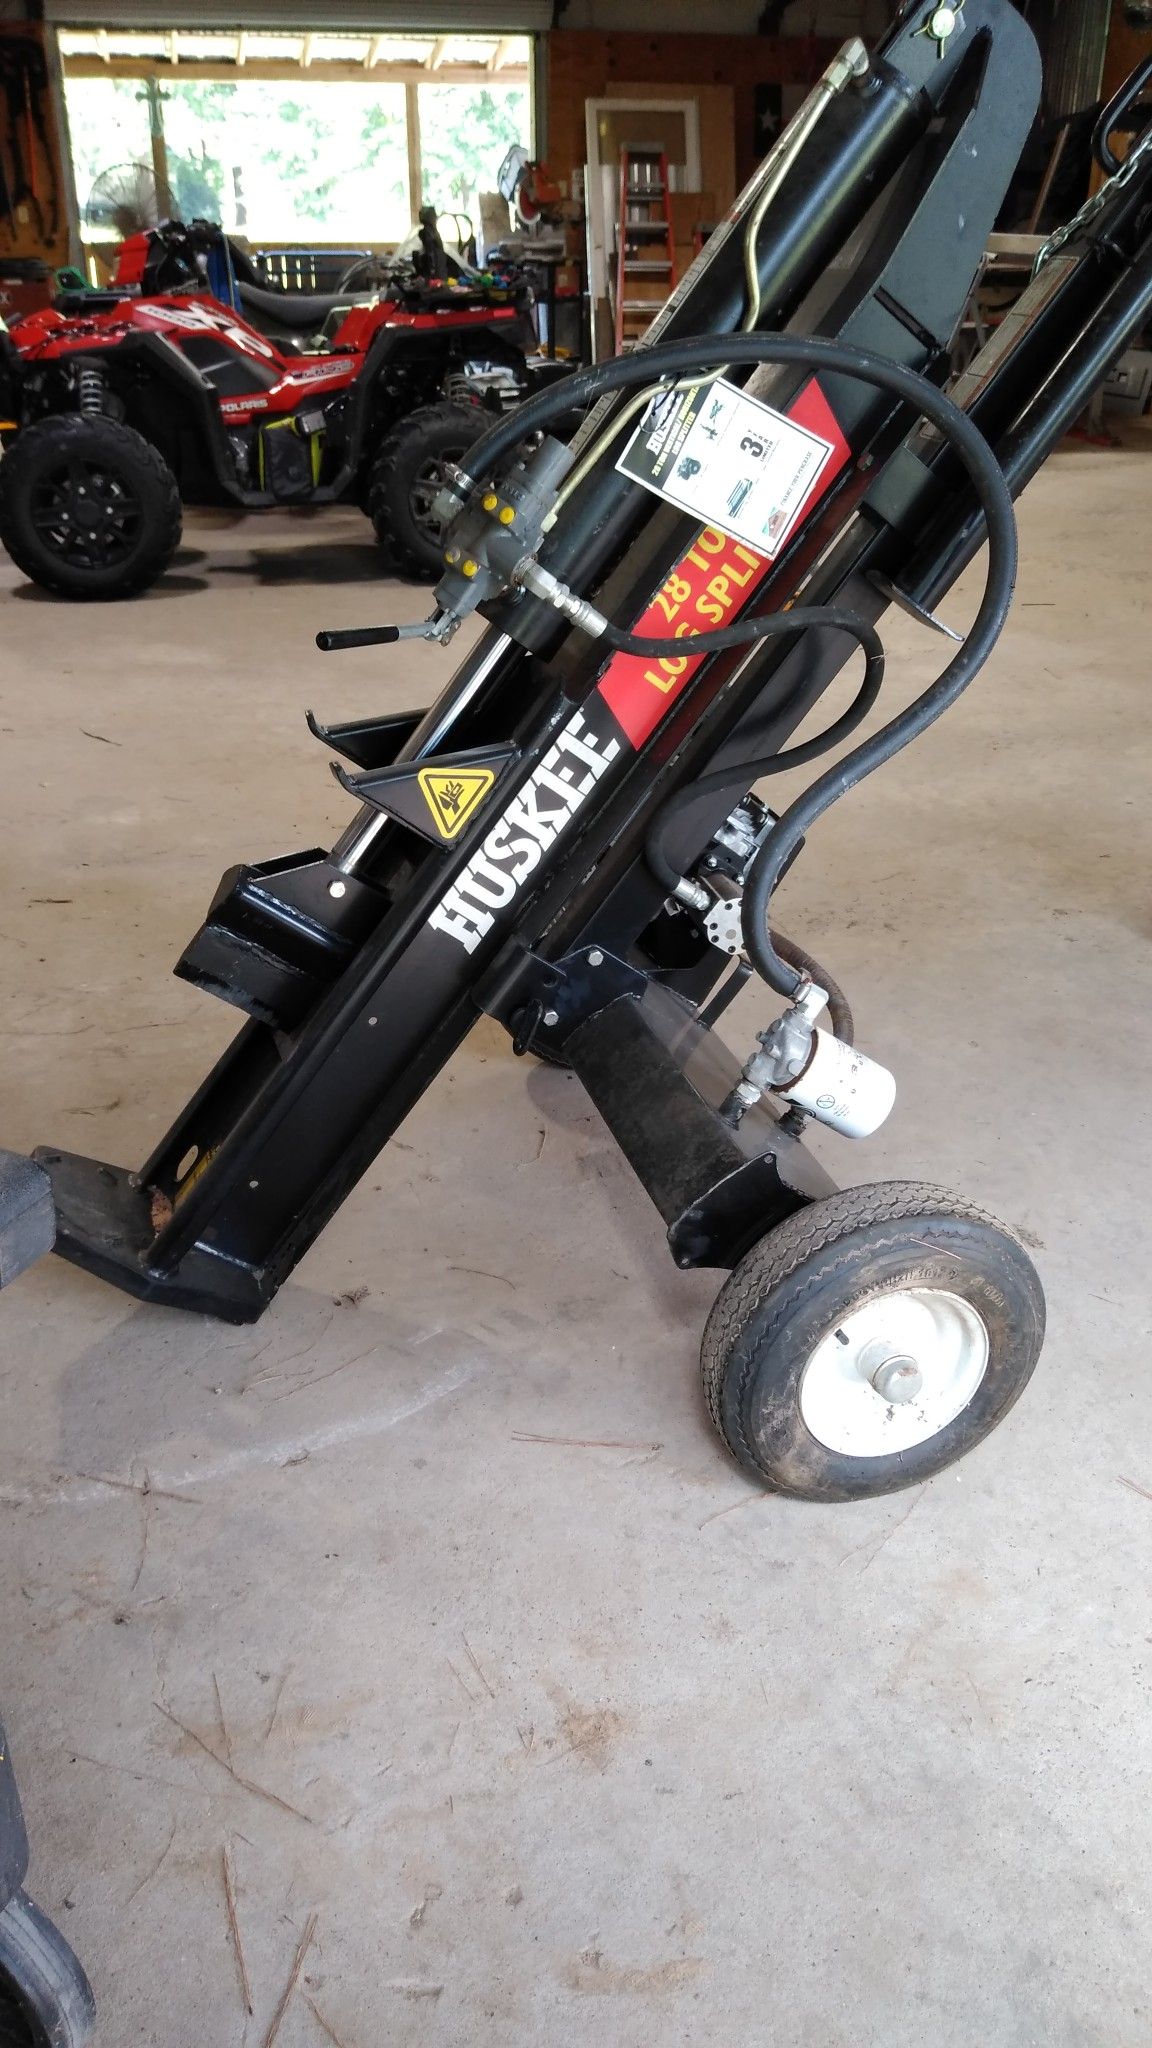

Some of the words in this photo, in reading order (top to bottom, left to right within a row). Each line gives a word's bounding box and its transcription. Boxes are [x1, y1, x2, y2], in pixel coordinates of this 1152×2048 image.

[220, 399, 268, 412] POLARIS
[740, 437, 764, 458] 3
[649, 573, 692, 623] 28
[686, 525, 726, 572] TO
[695, 546, 761, 624] SPLI
[427, 711, 621, 955] HUSKEE
